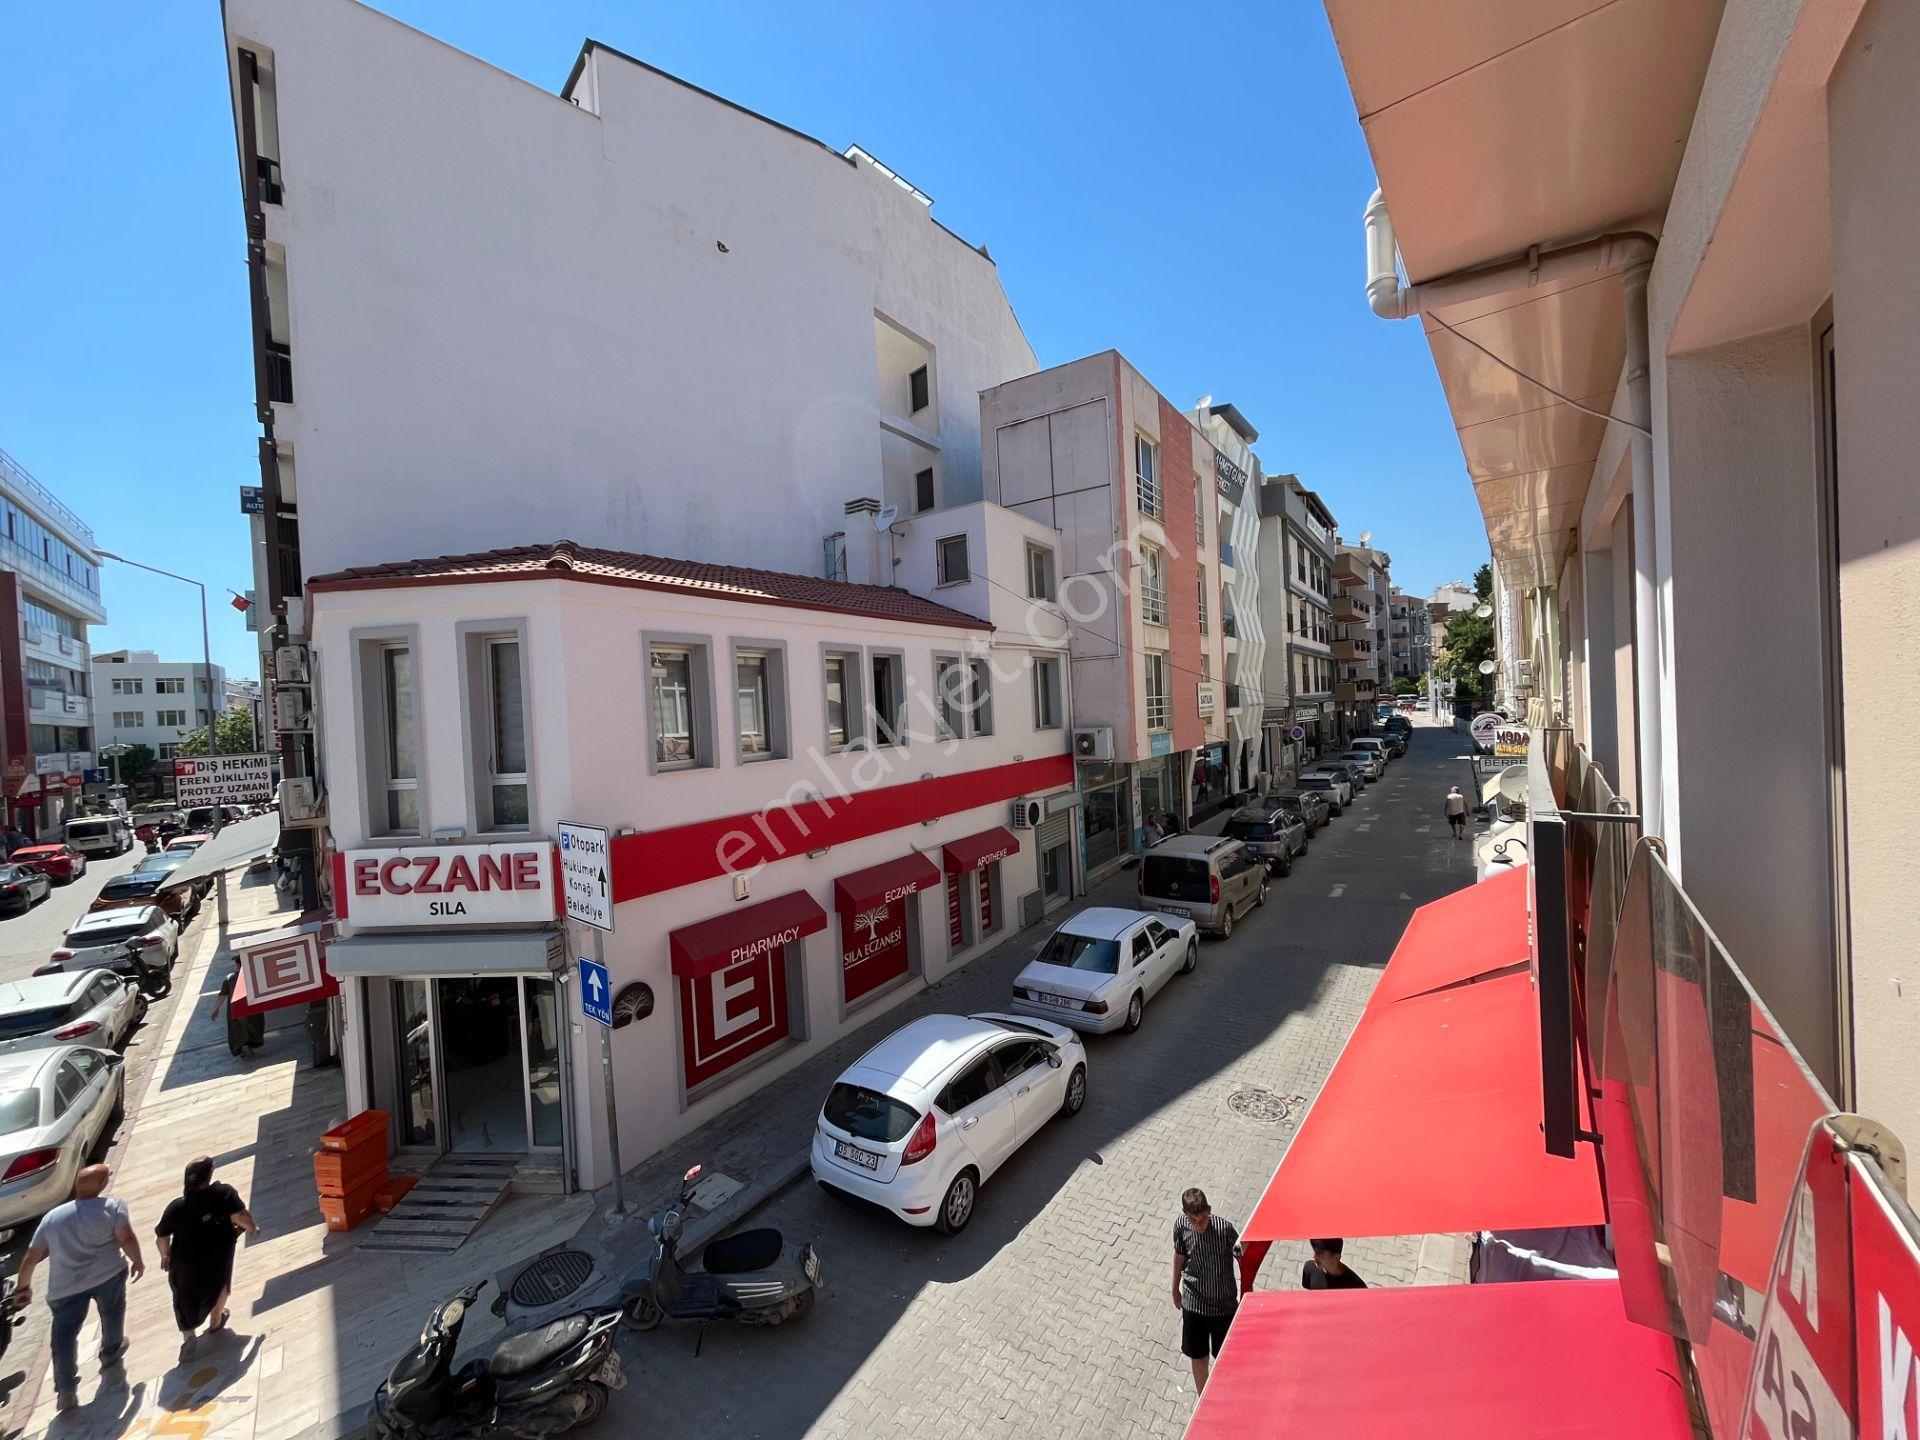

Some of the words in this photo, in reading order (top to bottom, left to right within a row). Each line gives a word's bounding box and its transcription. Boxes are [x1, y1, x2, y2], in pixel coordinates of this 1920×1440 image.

[179, 776, 210, 786] EREN
[180, 786, 224, 797] PROTEZ
[227, 782, 269, 793] UZMANI
[181, 797, 212, 808] 0532
[216, 795, 237, 804] 769
[570, 834, 605, 855] Otopark
[977, 847, 1008, 867] APOTHEKE
[353, 852, 541, 896] ECZANE
[885, 881, 917, 903] ECZANE
[429, 901, 467, 916] SILA
[567, 895, 603, 920] Belediye
[731, 926, 800, 964] PHARMACY
[844, 948, 862, 966] SILA
[864, 926, 901, 956] ECZANESİ
[262, 949, 301, 989] E
[710, 956, 760, 1041] E
[584, 1002, 597, 1016] TEK
[597, 1007, 610, 1021] YÖN
[838, 1144, 848, 1156] 35
[866, 1154, 876, 1167] 23
